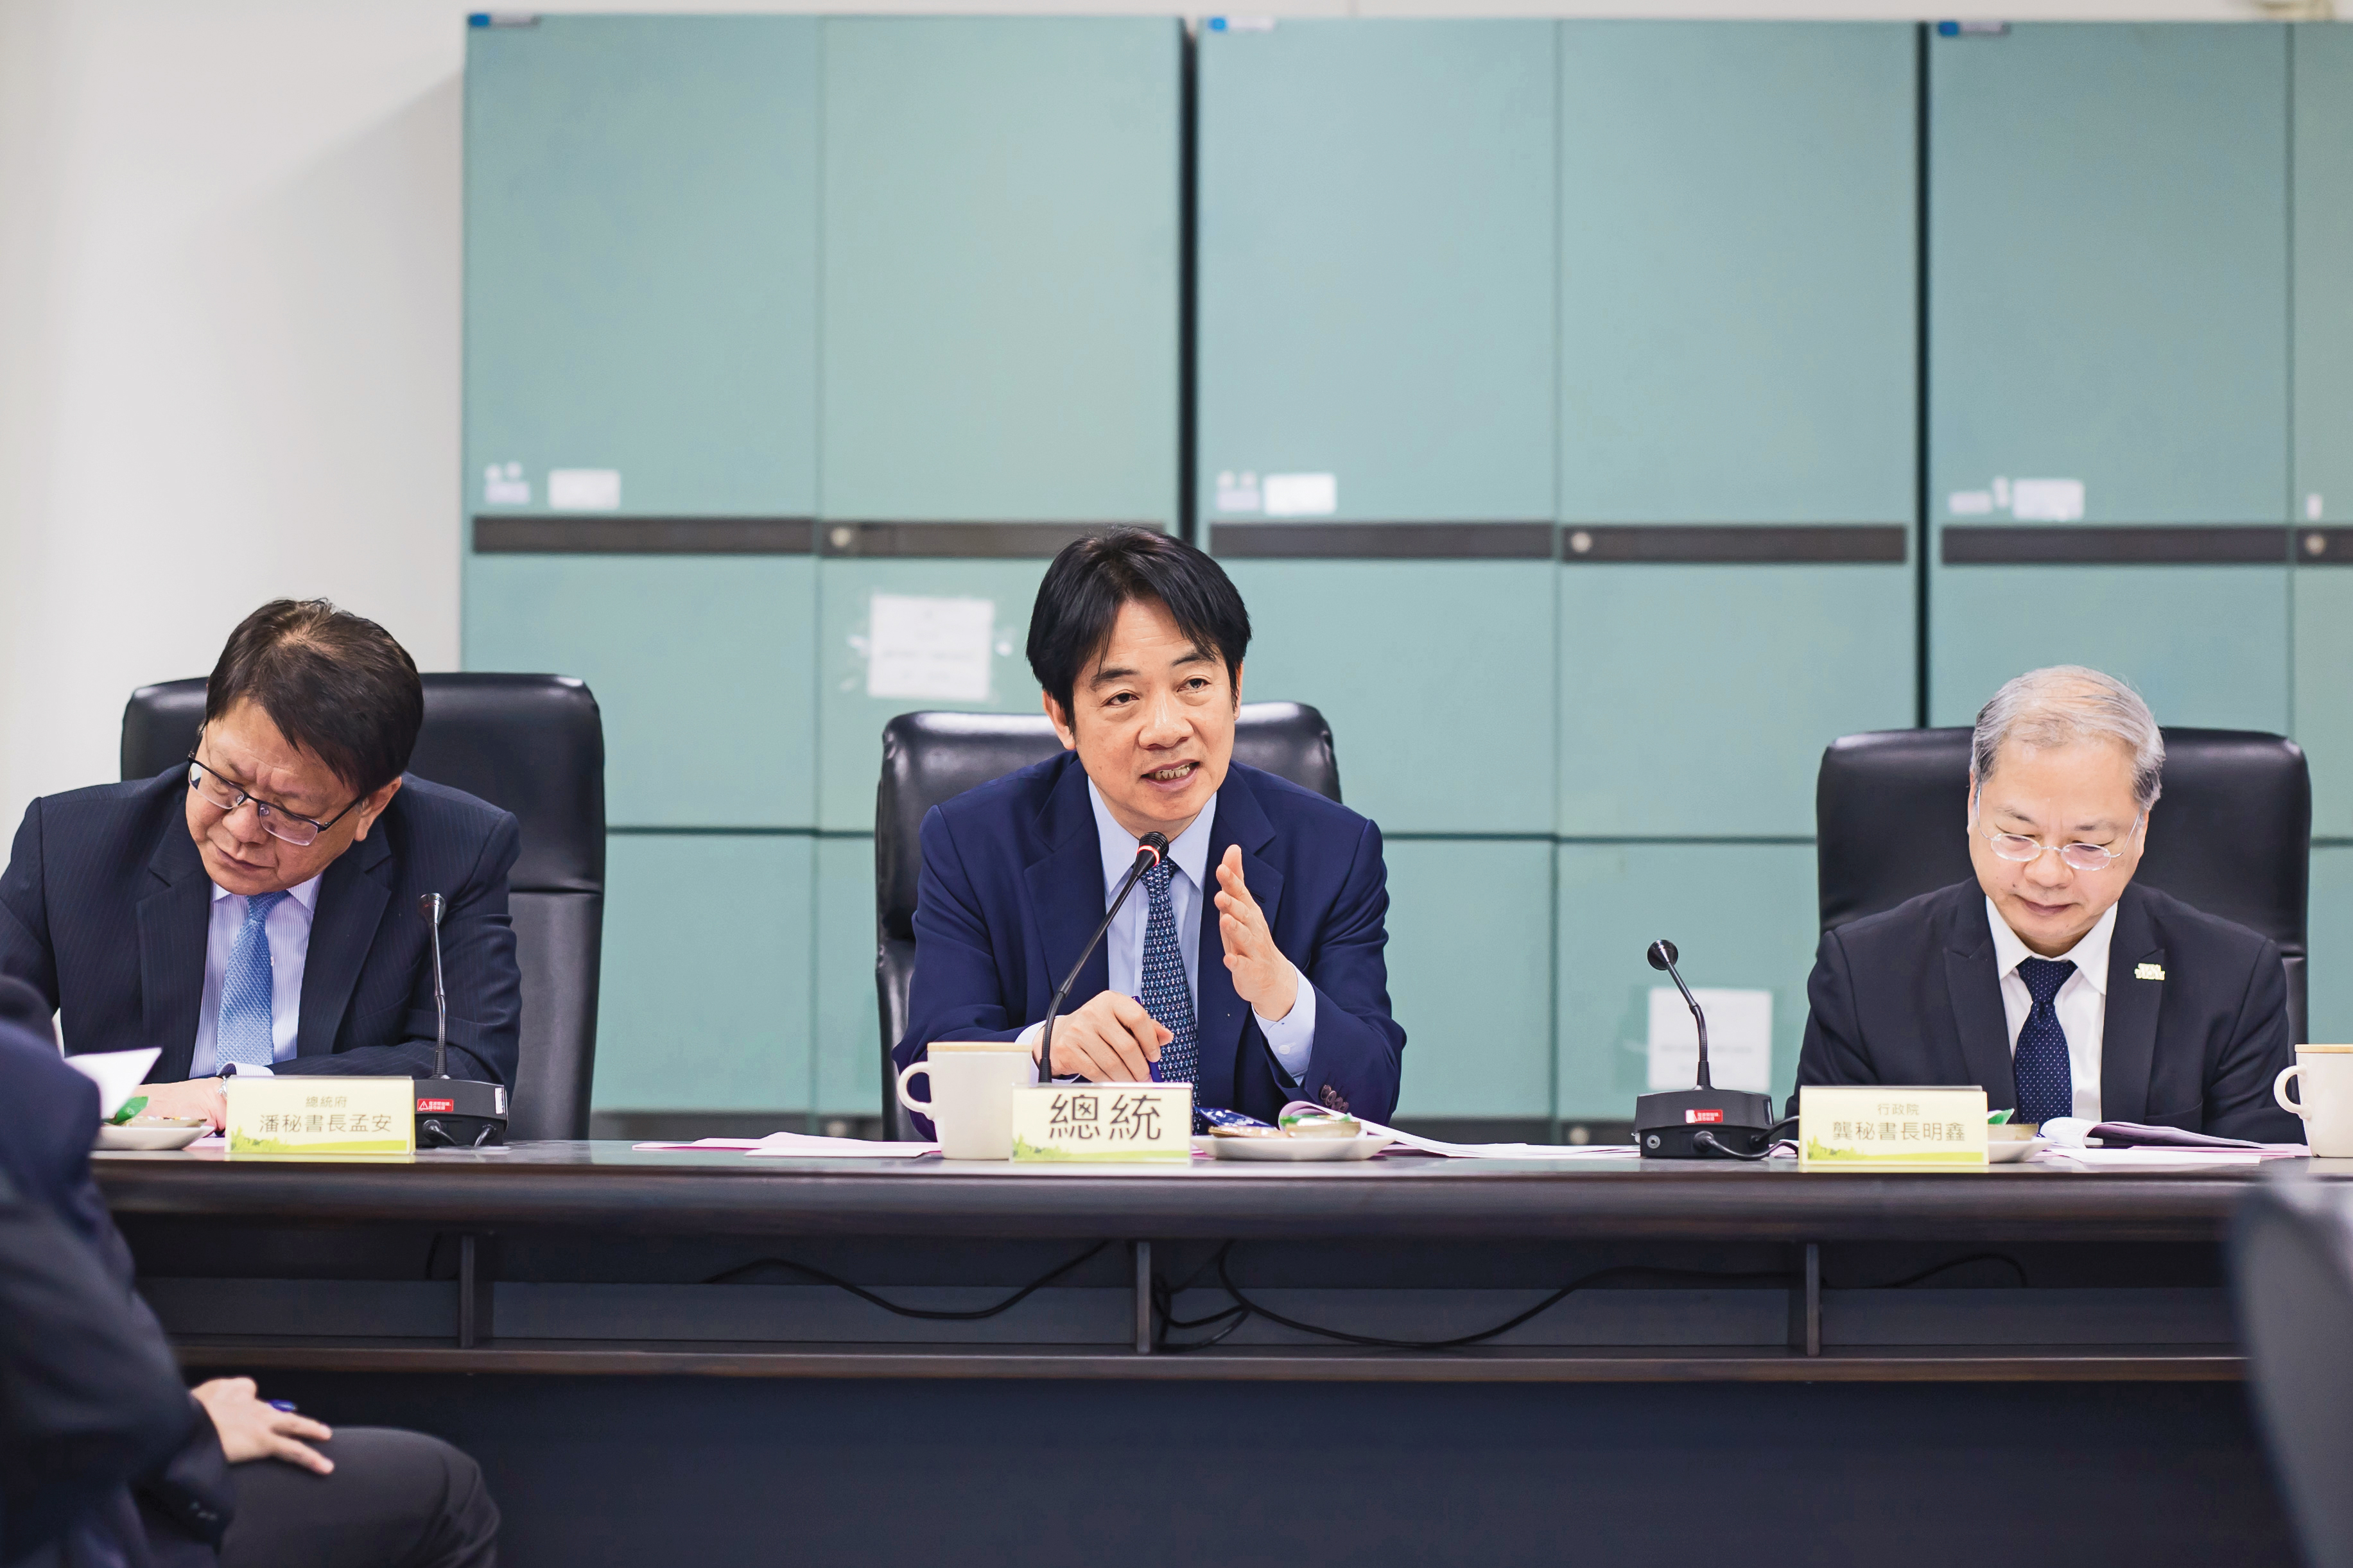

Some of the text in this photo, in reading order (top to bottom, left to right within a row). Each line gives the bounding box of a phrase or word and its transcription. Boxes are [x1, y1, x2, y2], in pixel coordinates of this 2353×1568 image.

[305, 1096, 347, 1108] 總統府
[1877, 1103, 1920, 1116] 行政院
[259, 1114, 392, 1133] 潘秘書長孟安
[1049, 1094, 1161, 1140] 總統
[1832, 1121, 1965, 1141] 龔秘書長明鑫
